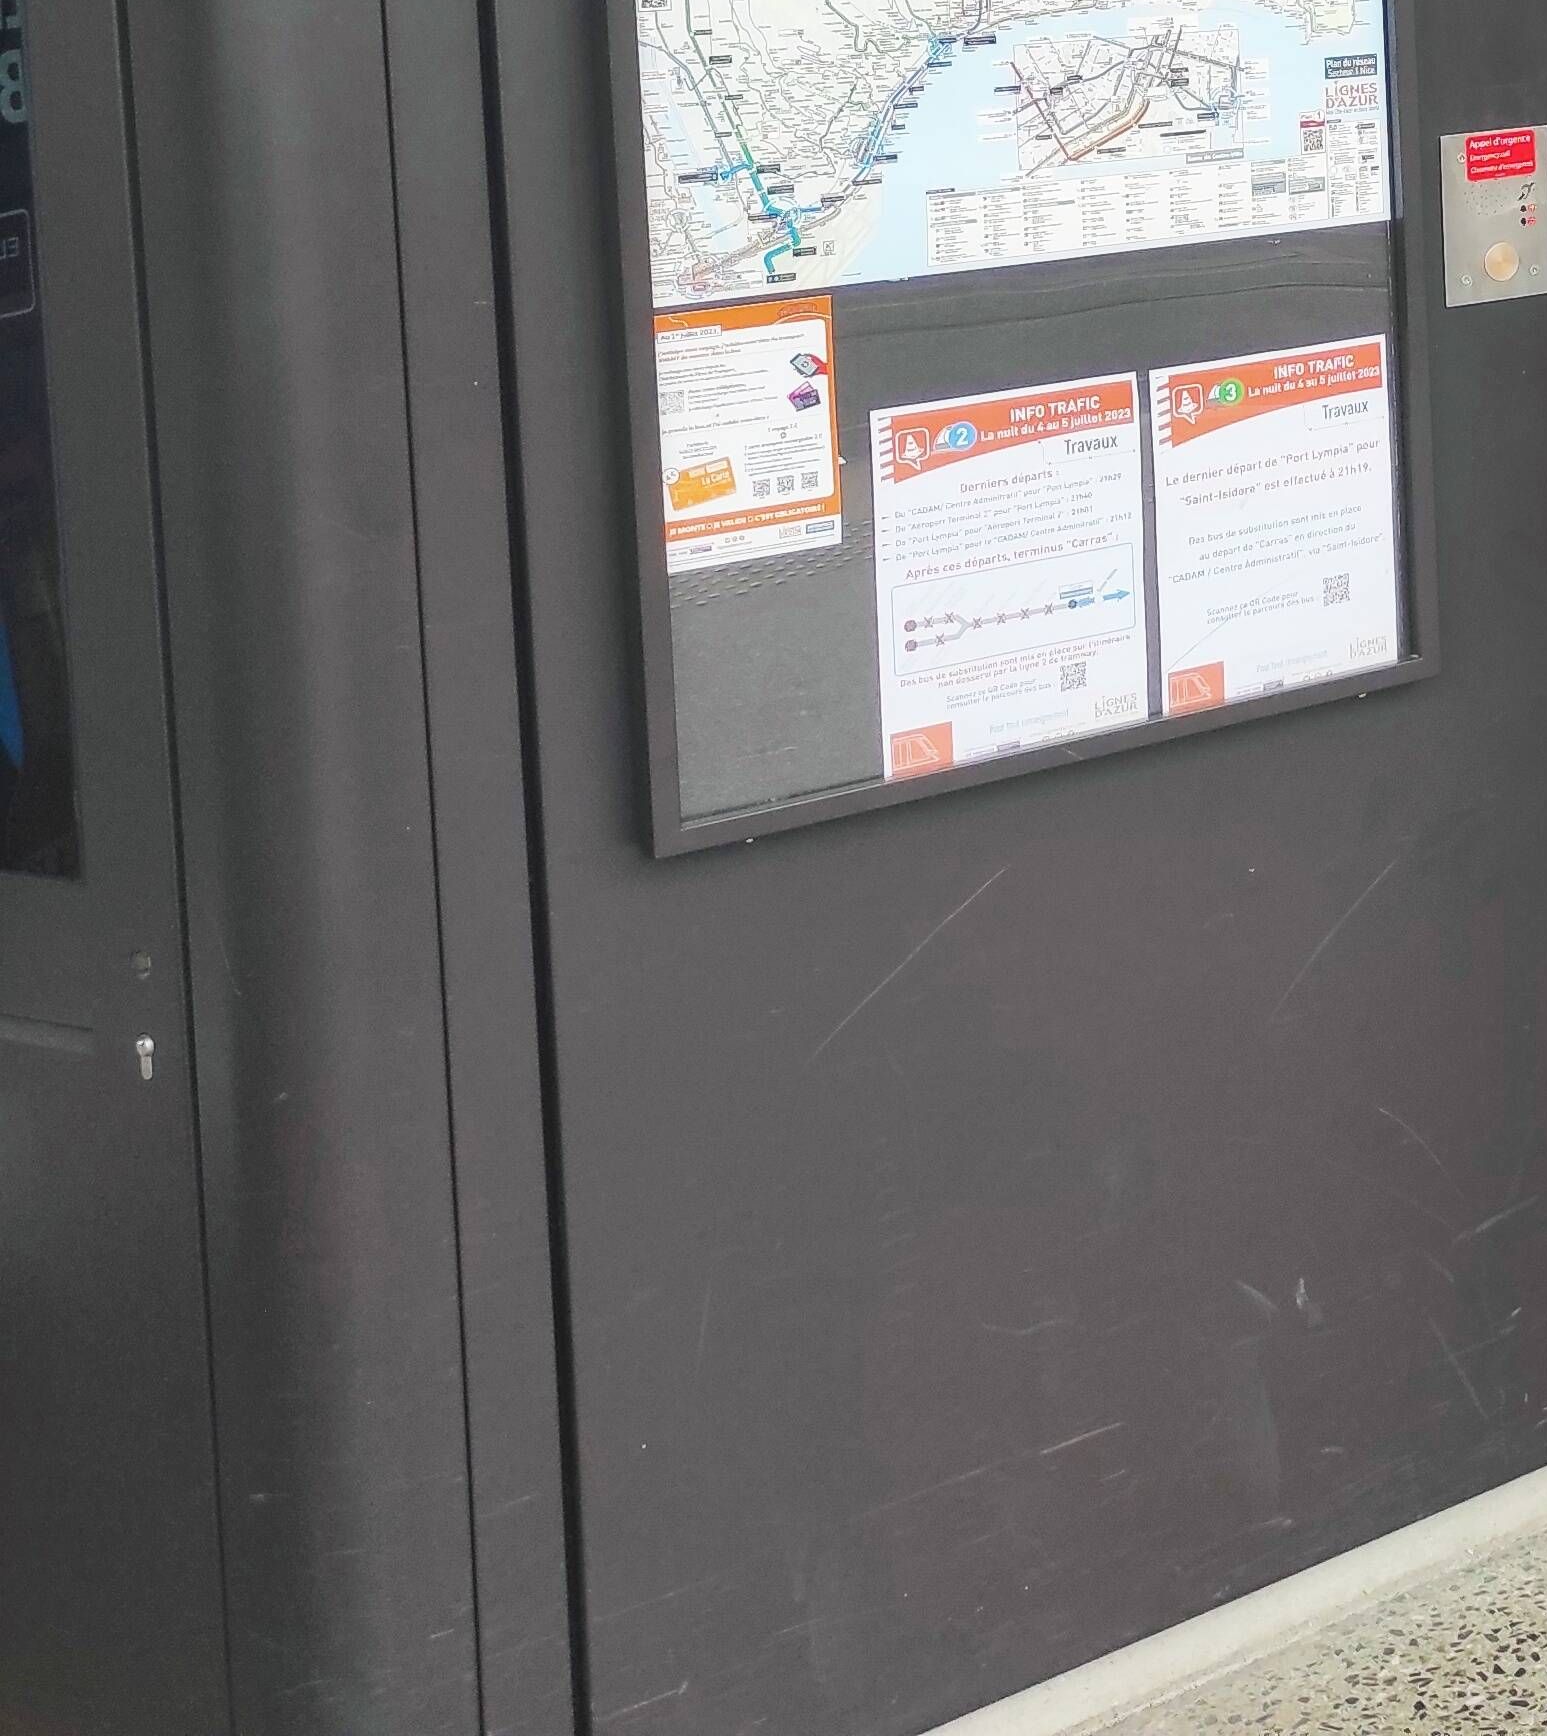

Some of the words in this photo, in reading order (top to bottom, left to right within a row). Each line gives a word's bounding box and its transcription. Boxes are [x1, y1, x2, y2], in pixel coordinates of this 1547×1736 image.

[1327, 60, 1342, 69] Plan
[1343, 58, 1353, 66] du
[1325, 82, 1378, 97] LIGNES
[1326, 95, 1378, 109] D'AZUR
[1470, 138, 1492, 149] Appel
[1274, 363, 1304, 380] INFO
[1309, 354, 1354, 374] TRAFIC
[1226, 385, 1237, 401] 3
[1248, 387, 1261, 398] La
[1263, 383, 1282, 396] nuit
[1283, 380, 1296, 392] du
[1306, 377, 1318, 388] au
[1327, 370, 1357, 387] juillet
[1358, 366, 1380, 379] 2023
[1010, 405, 1045, 423] INFO
[1049, 395, 1100, 414] TRAFIC
[1322, 400, 1369, 420] Travaux
[956, 427, 968, 446] 2
[980, 430, 995, 442] La
[997, 427, 1019, 440] nuit
[1021, 422, 1035, 435] du
[1037, 421, 1044, 432] 4
[1046, 418, 1059, 430] au
[1070, 411, 1103, 430] juillet
[1105, 407, 1131, 421] 2023
[1064, 435, 1118, 455] Travaux
[1166, 477, 1179, 487] Le
[1182, 468, 1224, 484] dernier
[1227, 461, 1262, 478] départ
[1265, 457, 1278, 468] de
[1281, 453, 1309, 465] "Port
[1312, 443, 1354, 460] Lympia"
[1356, 440, 1379, 454] pour
[960, 476, 1009, 494] Derniers
[1011, 470, 1053, 486] départs
[1180, 482, 1261, 506] "Saint-Isidore"
[1264, 480, 1280, 491] est
[1283, 471, 1326, 488] effectué
[1329, 467, 1335, 479] à
[1338, 463, 1372, 478] 21h19.
[1188, 536, 1205, 546] Des
[1207, 533, 1224, 542] bus
[1225, 530, 1237, 539] de
[1239, 519, 1289, 536] substitution
[1290, 515, 1309, 525] sont
[1340, 504, 1362, 517] place
[1199, 551, 1210, 561] au
[1212, 544, 1242, 560] départ
[1294, 533, 1305, 542] en
[1307, 524, 1343, 540] direction
[906, 565, 939, 580] Après
[942, 561, 962, 572] ces
[964, 551, 1011, 570] départs,
[1013, 540, 1063, 559] terminus
[1067, 532, 1114, 550] "Carras"
[1168, 570, 1205, 584] "CADAM
[1213, 563, 1243, 575] Centre
